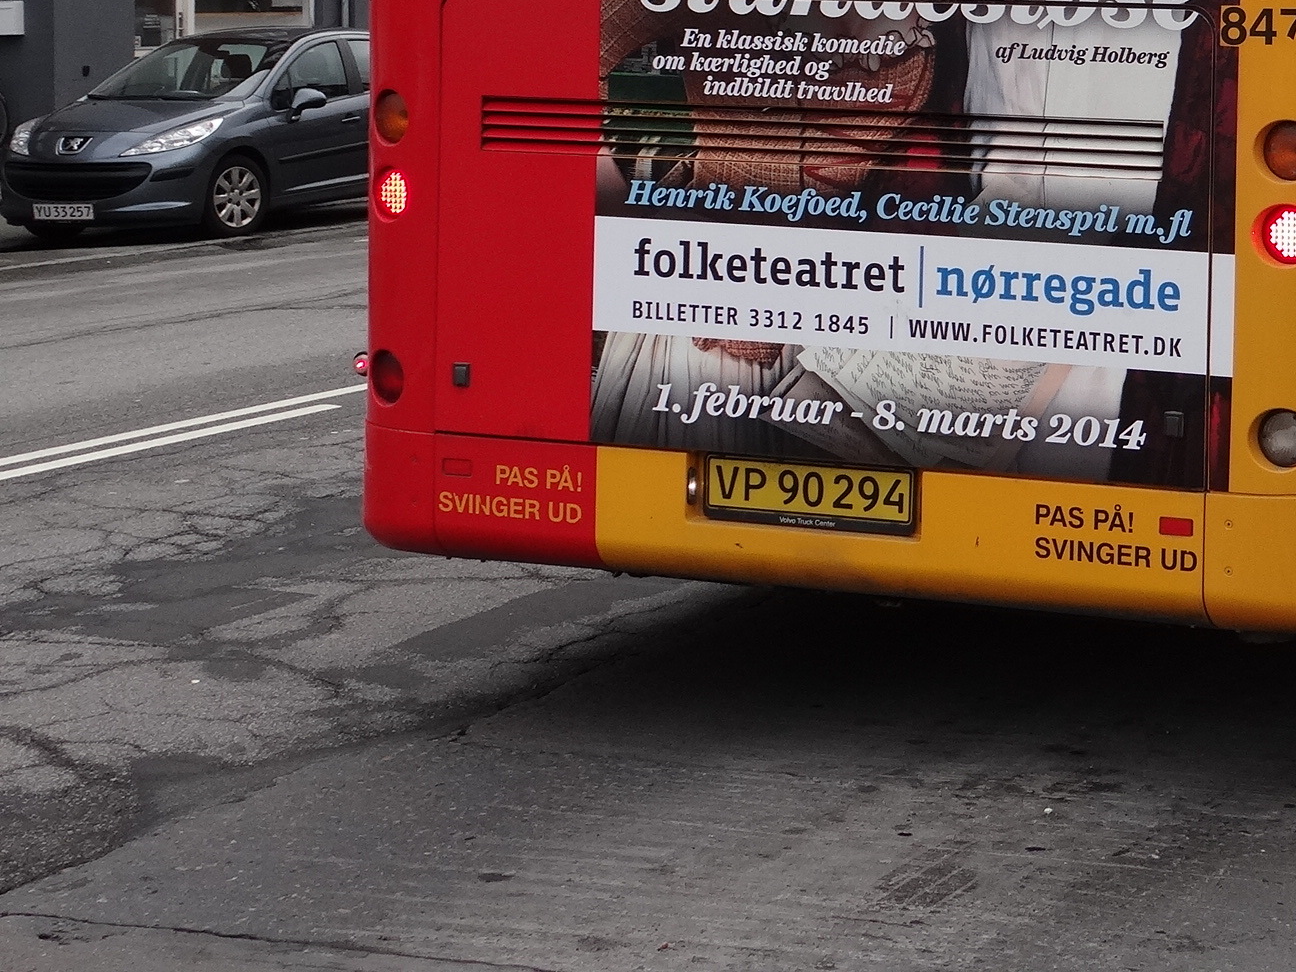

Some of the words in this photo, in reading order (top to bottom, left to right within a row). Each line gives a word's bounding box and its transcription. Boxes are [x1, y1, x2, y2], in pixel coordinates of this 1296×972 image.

[680, 28, 713, 48] En
[716, 29, 808, 53] klassisk
[811, 33, 906, 56] komedie
[995, 42, 1019, 65] af
[1017, 43, 1089, 65] Ludvig
[1090, 46, 1170, 69] Holberg
[652, 55, 686, 71] om
[689, 52, 801, 78] kærlighed
[804, 59, 832, 80] og
[703, 76, 794, 99] indbildt
[797, 82, 893, 103] travlhed
[624, 179, 736, 211] Henrik
[737, 185, 868, 223] Koefoed,
[876, 193, 980, 224] Cecilie
[984, 199, 1121, 237] Stenspil
[633, 237, 905, 294] folketeatret
[936, 265, 1181, 316] nørregade
[632, 300, 738, 326] BILLETTER
[749, 308, 803, 330] 3312
[814, 313, 869, 335] 1845
[909, 318, 1182, 358] WWW.FOLKETEATRET.DK
[680, 382, 843, 425] februar
[872, 399, 905, 431] 8.
[916, 407, 1039, 442] marts
[1045, 413, 1147, 451] 2014
[495, 464, 539, 488] PAS
[546, 464, 582, 492] PÅ!
[438, 491, 540, 521] SVINGER
[548, 501, 582, 524] UD
[779, 516, 796, 524] Volvo
[797, 517, 814, 526] Truck
[815, 519, 836, 527] Center
[1034, 503, 1084, 530] PAS
[1094, 504, 1134, 534] PÅ!
[1034, 536, 1151, 568] SVINGER
[1161, 548, 1198, 572] UD
